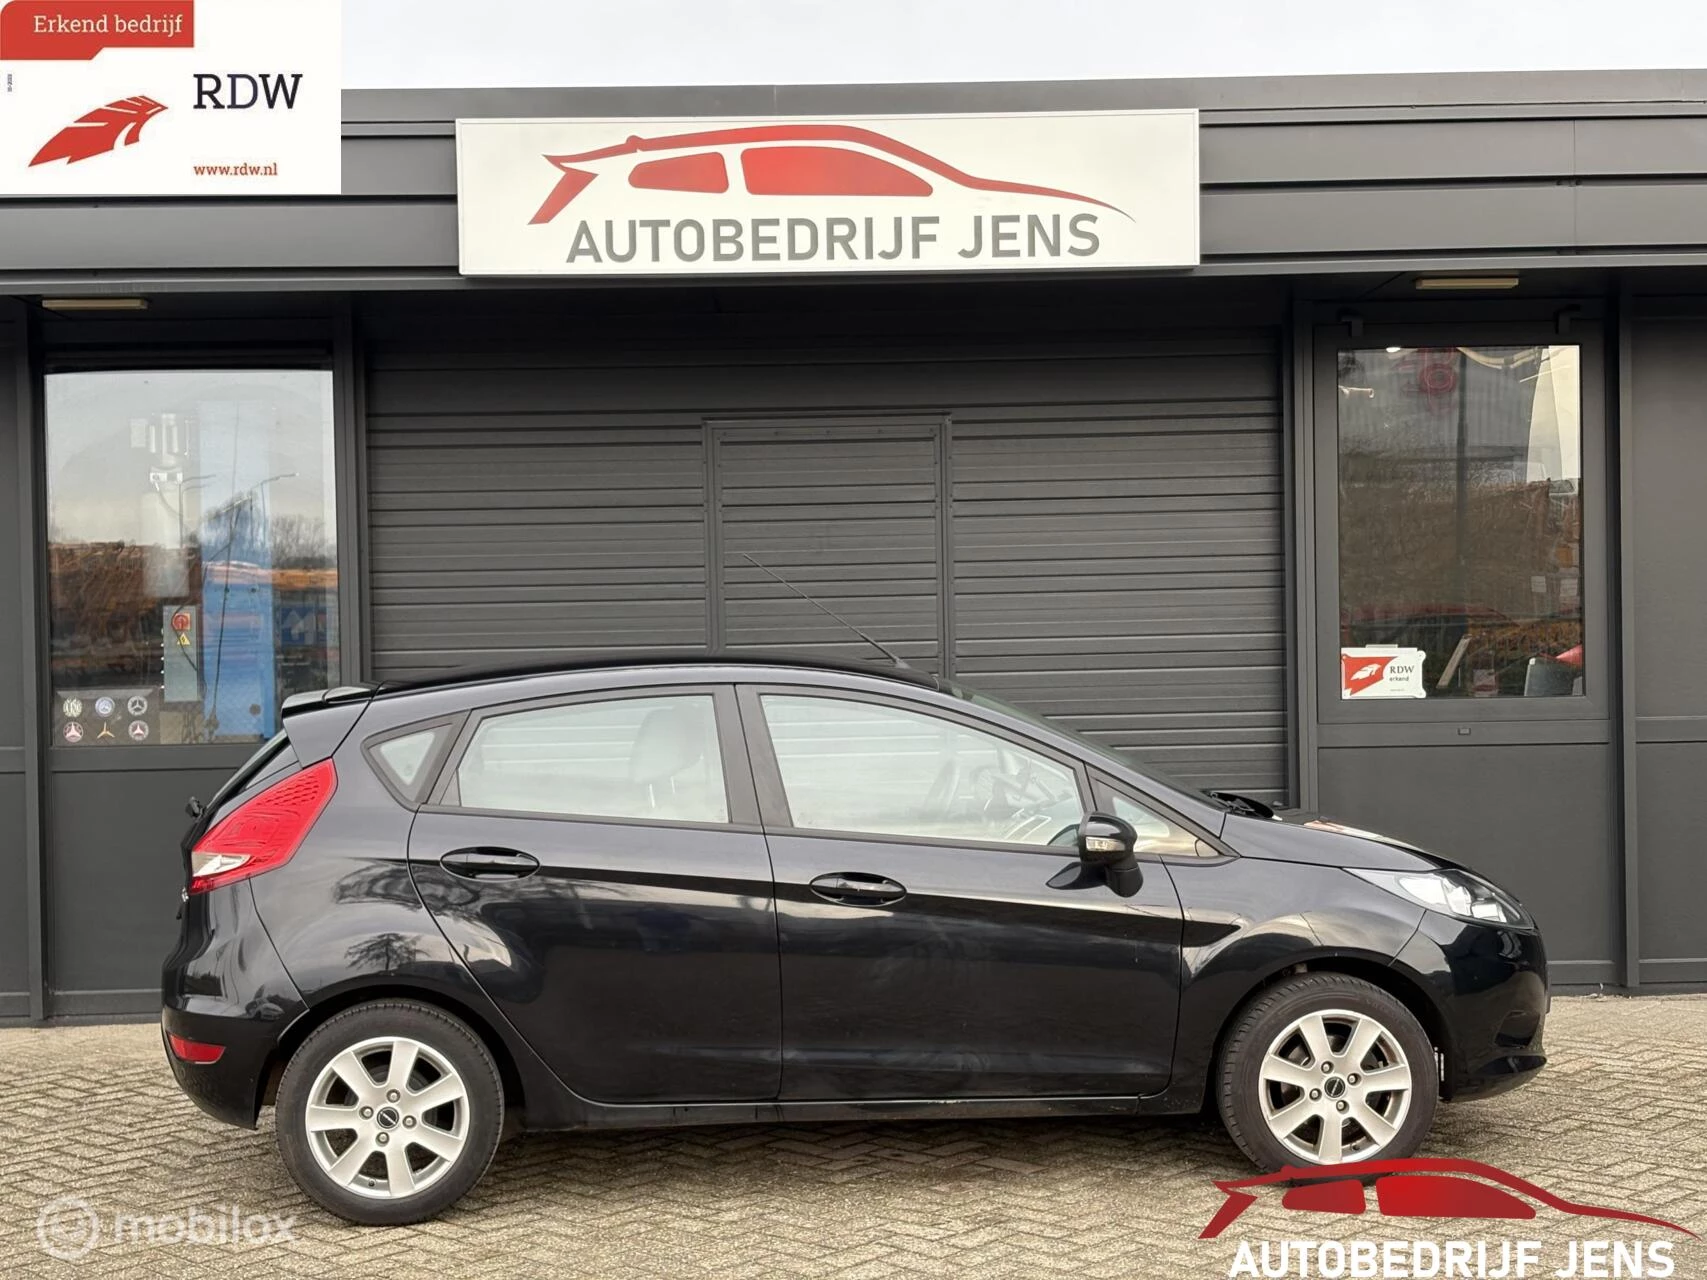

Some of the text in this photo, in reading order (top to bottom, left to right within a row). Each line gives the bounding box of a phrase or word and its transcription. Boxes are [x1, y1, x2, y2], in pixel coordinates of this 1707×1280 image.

[566, 213, 1100, 263] AUTOBEDRIJF JENS
[1390, 665, 1415, 674] RDW
